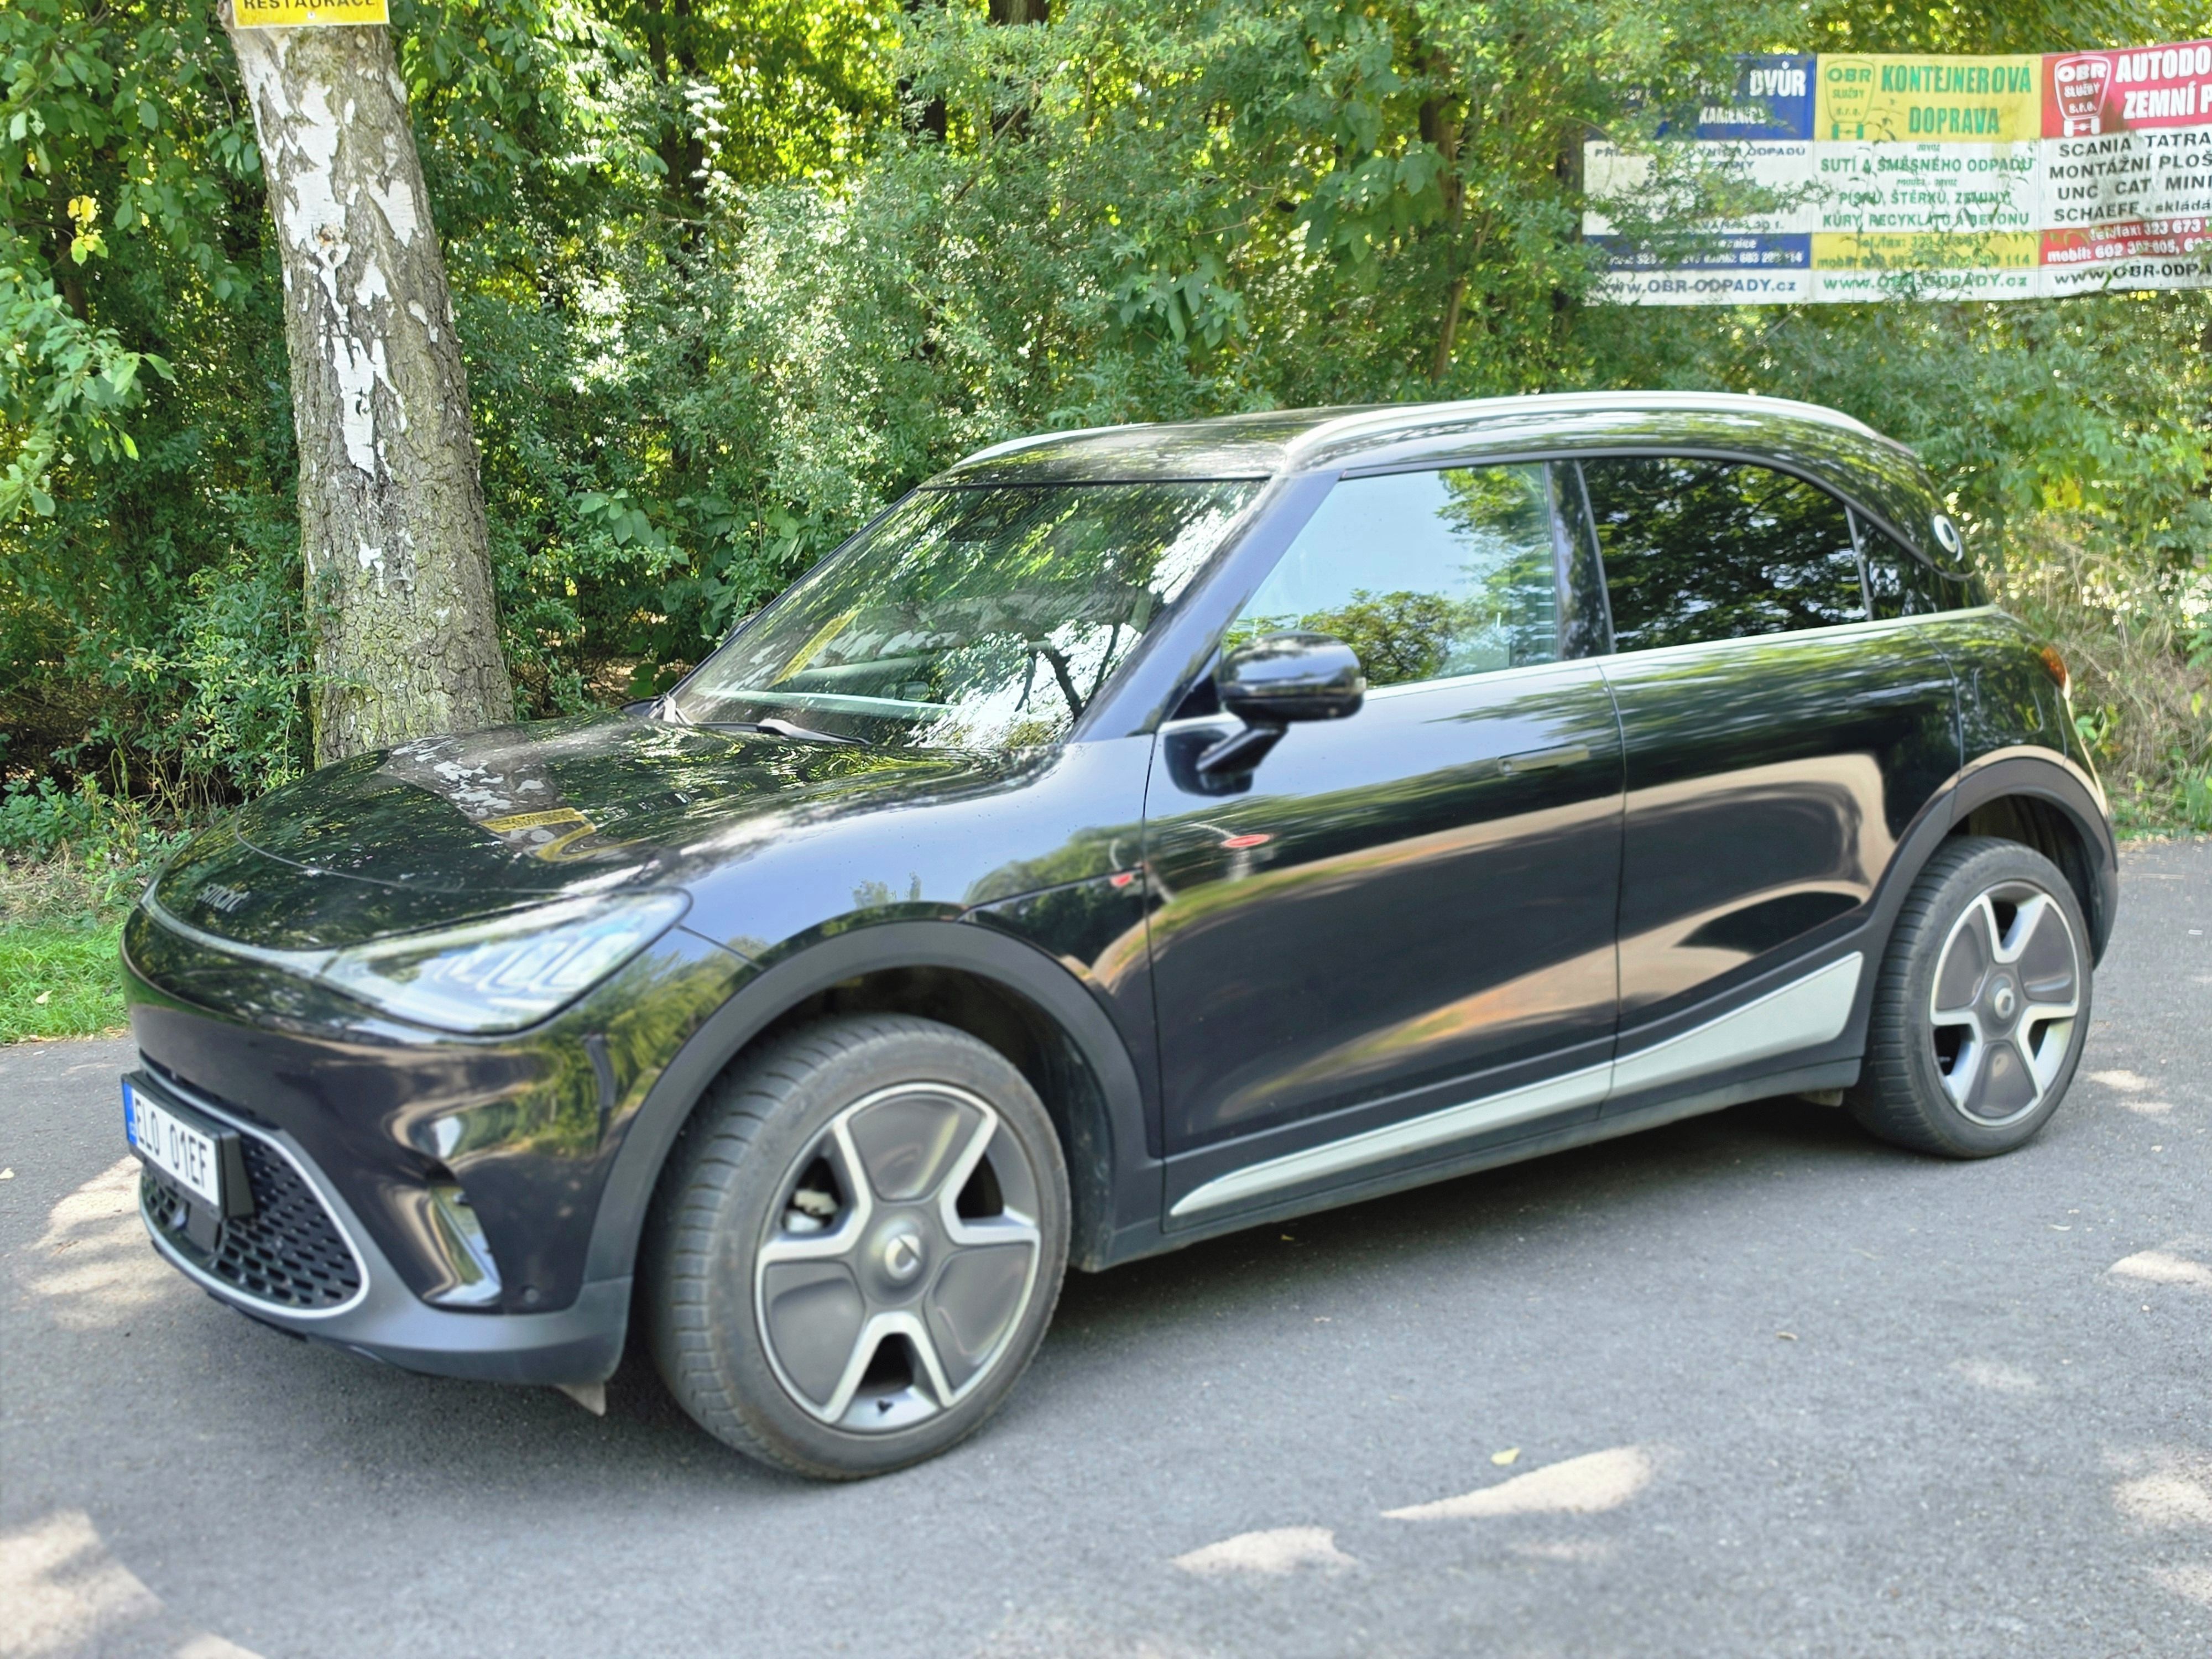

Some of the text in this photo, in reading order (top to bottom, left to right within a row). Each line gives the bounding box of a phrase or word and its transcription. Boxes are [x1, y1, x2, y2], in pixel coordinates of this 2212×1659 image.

[1749, 61, 1807, 97] DVŮR
[1827, 67, 1871, 83] OBR
[1881, 61, 2032, 93] KONTEJNEROVÁ
[2057, 62, 2107, 82] OBR
[2123, 80, 2197, 119] ZEMNÍ
[1908, 106, 2000, 134] DOPRAVA
[2059, 132, 2211, 157] SCANIA TATRA
[1820, 155, 1856, 172] SUTÍ
[2049, 153, 2151, 180] MONTÁŽNÍ
[2057, 185, 2098, 201] UNC
[2114, 178, 2152, 195] CAT
[2054, 200, 2140, 222] SCHAEFF
[2172, 218, 2201, 233] 673
[2095, 242, 2124, 258] 602
